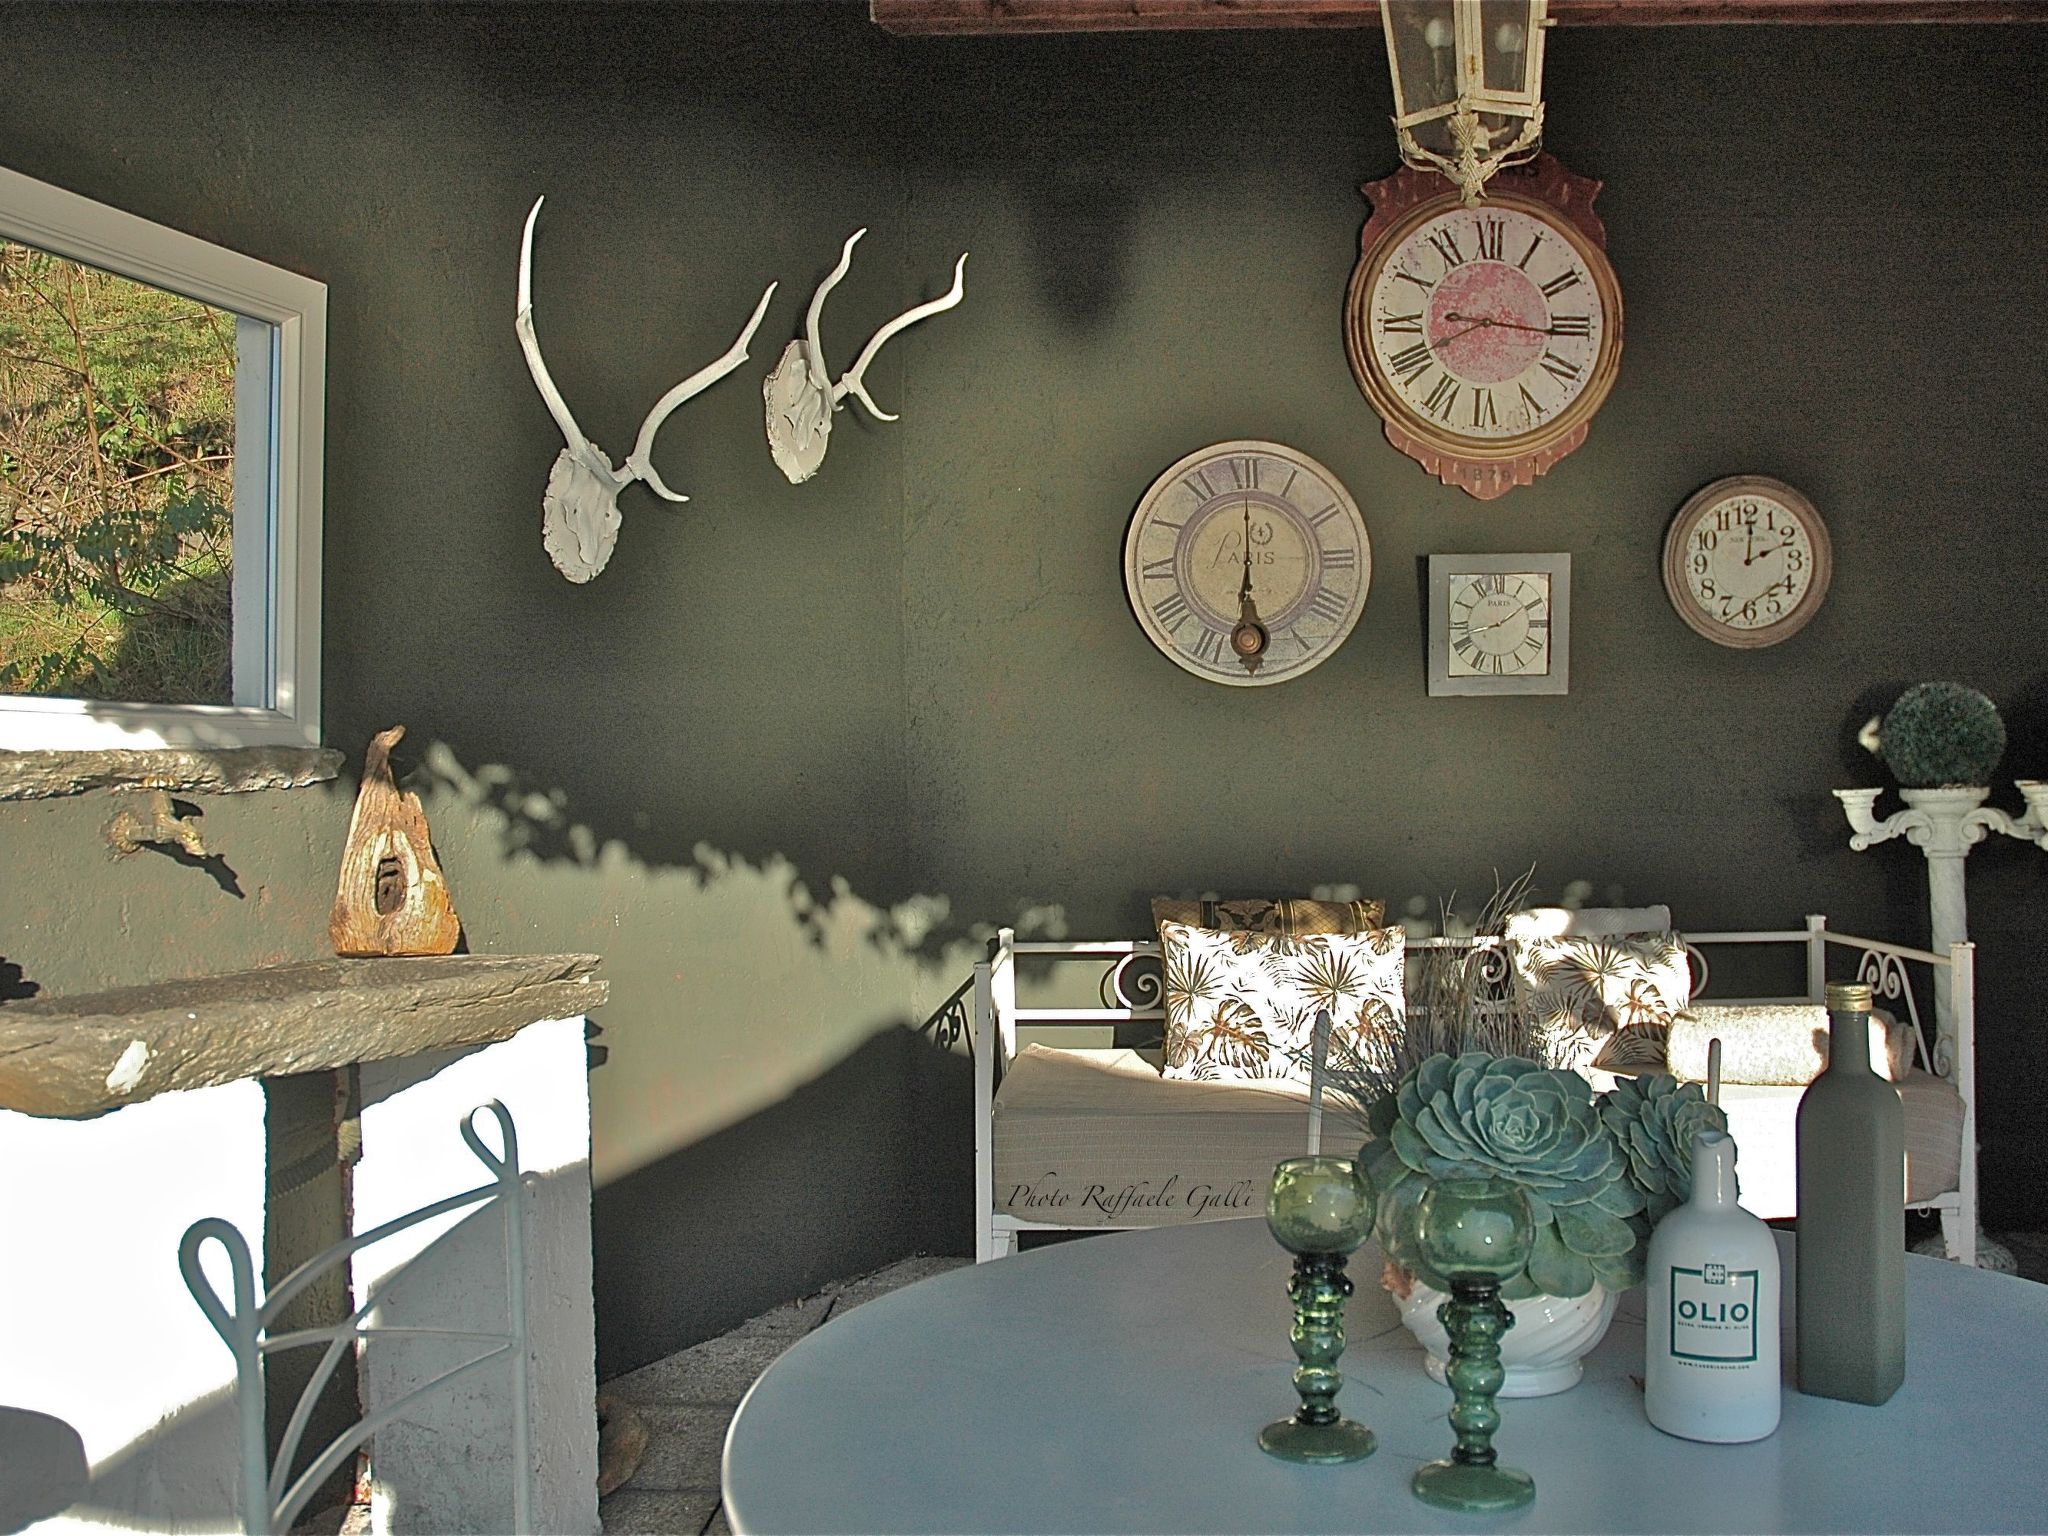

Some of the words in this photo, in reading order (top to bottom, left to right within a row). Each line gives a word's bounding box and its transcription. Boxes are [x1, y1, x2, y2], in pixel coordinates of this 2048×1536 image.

[1425, 226, 1467, 273] XI
[1473, 220, 1505, 261] XII
[1515, 231, 1548, 272] I
[1392, 261, 1437, 298] X
[1538, 266, 1584, 302] II
[1383, 306, 1423, 334] IX
[1550, 312, 1590, 341] III
[1388, 340, 1434, 389] VIII
[1420, 372, 1461, 422] VII
[1471, 387, 1502, 428] VI
[1518, 382, 1550, 421] V
[1279, 468, 1298, 498] I
[1309, 503, 1340, 528] II
[1716, 510, 1730, 531] 11
[1733, 503, 1758, 526] 12
[1767, 510, 1775, 531] 1
[1697, 529, 1717, 551] 10
[1780, 525, 1795, 547] 2
[1322, 549, 1354, 570] III
[1693, 554, 1708, 575] 9
[1787, 549, 1802, 572] 3
[1701, 578, 1716, 600] 8
[1778, 574, 1796, 595] 4
[1487, 599, 1511, 607] PARIS
[1720, 595, 1733, 617] 7
[1743, 600, 1757, 621] 6
[1766, 592, 1781, 614] 5
[1678, 1300, 1749, 1323] OLIO
